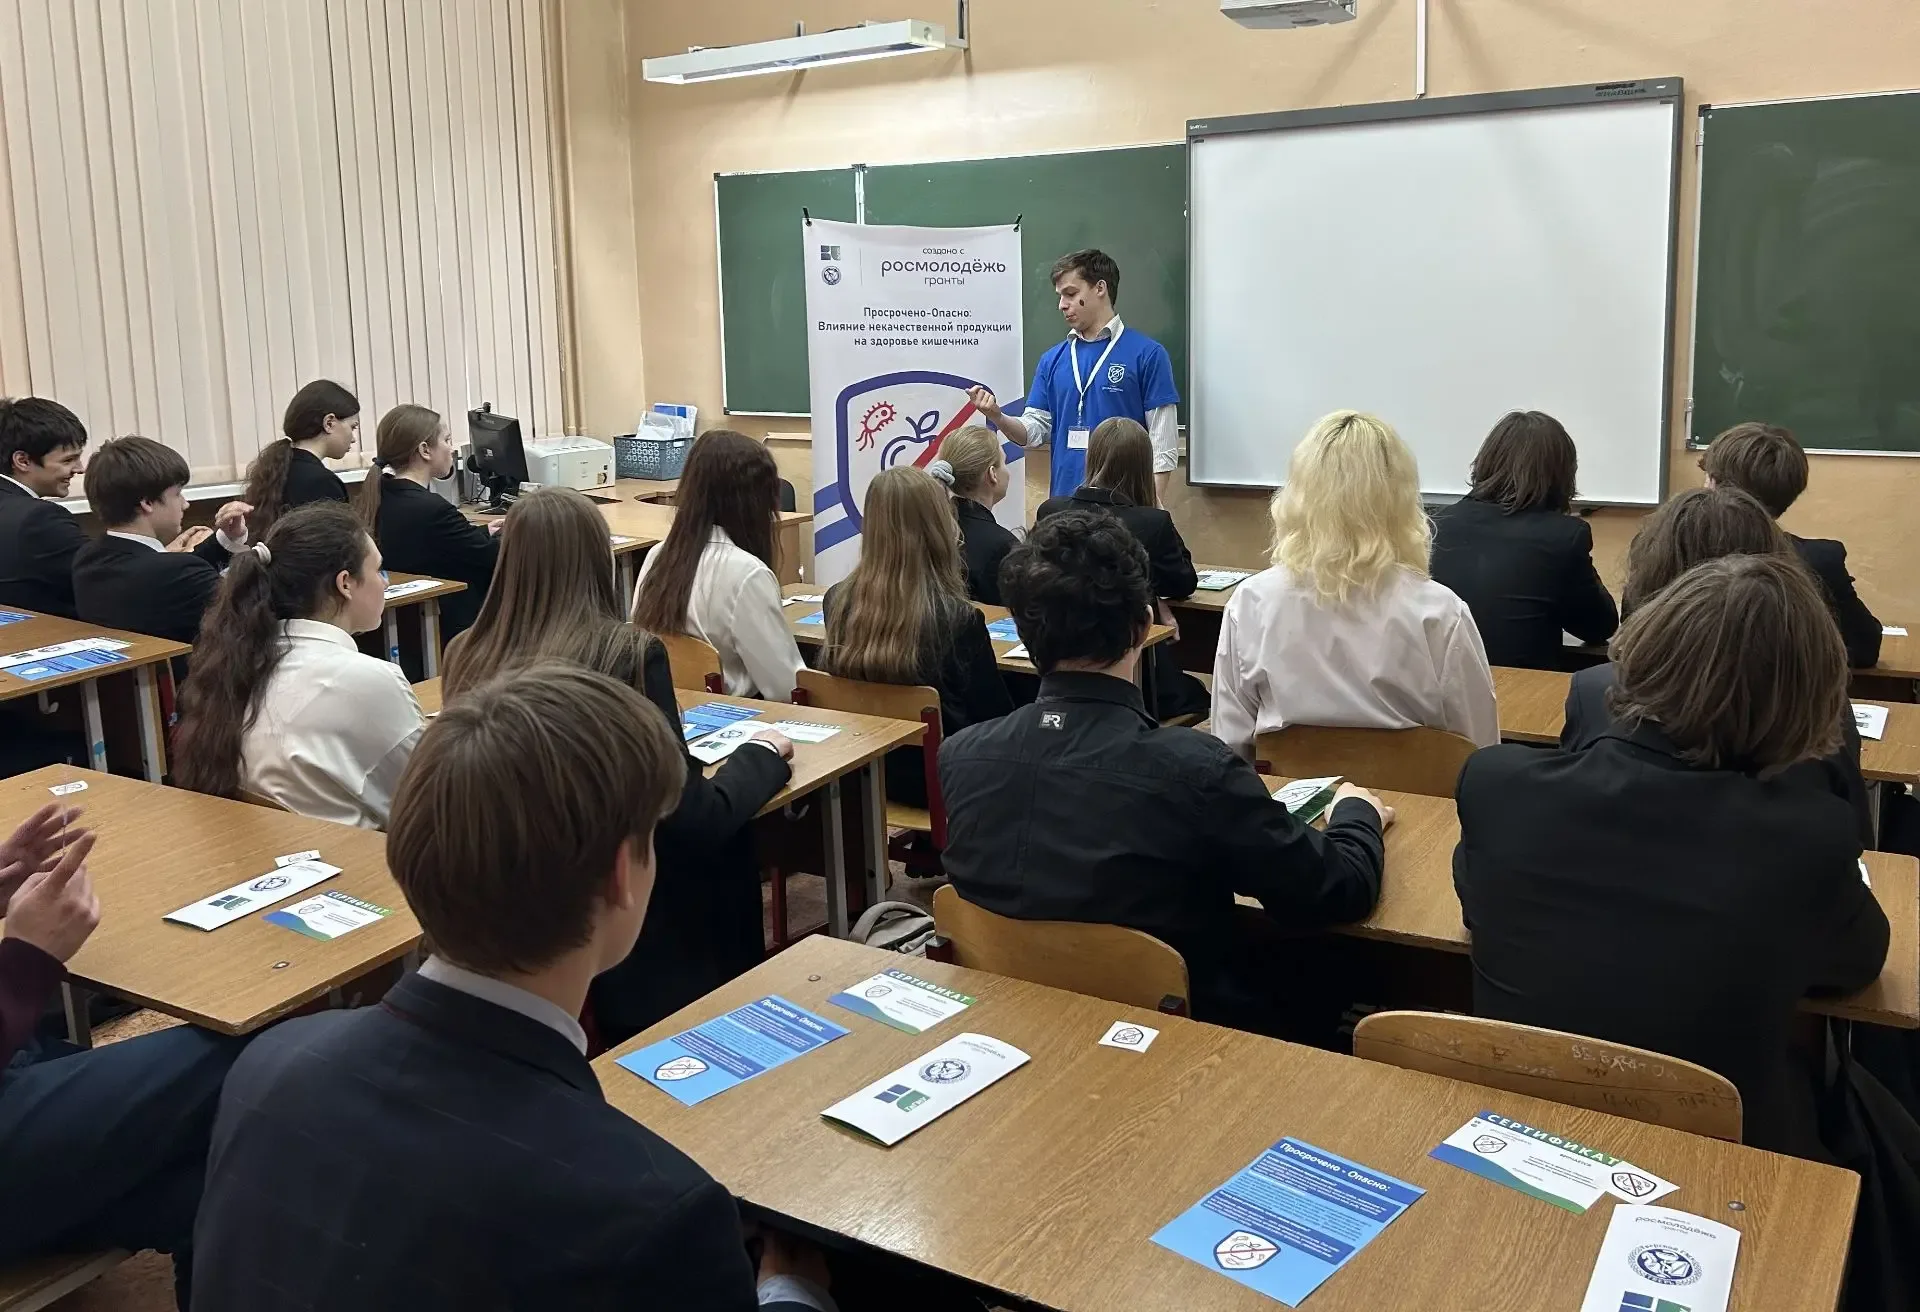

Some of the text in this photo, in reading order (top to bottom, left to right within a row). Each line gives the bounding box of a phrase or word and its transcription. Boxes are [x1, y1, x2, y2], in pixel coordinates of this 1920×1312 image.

[922, 247, 958, 256] создано
[881, 259, 1006, 277] росмолодёжь
[924, 276, 965, 287] гранты
[864, 307, 972, 319] Просрочено-Опасно:
[818, 321, 1012, 334] Влияние некачественной продукции
[854, 336, 979, 347] на здоровье кишечника
[889, 970, 969, 1002] СЕРТИФИКАТ
[1487, 1113, 1620, 1168] СЕРТИФИКАТ
[1280, 1142, 1341, 1173] Просрочено
[1347, 1169, 1391, 1192] Опасно:
